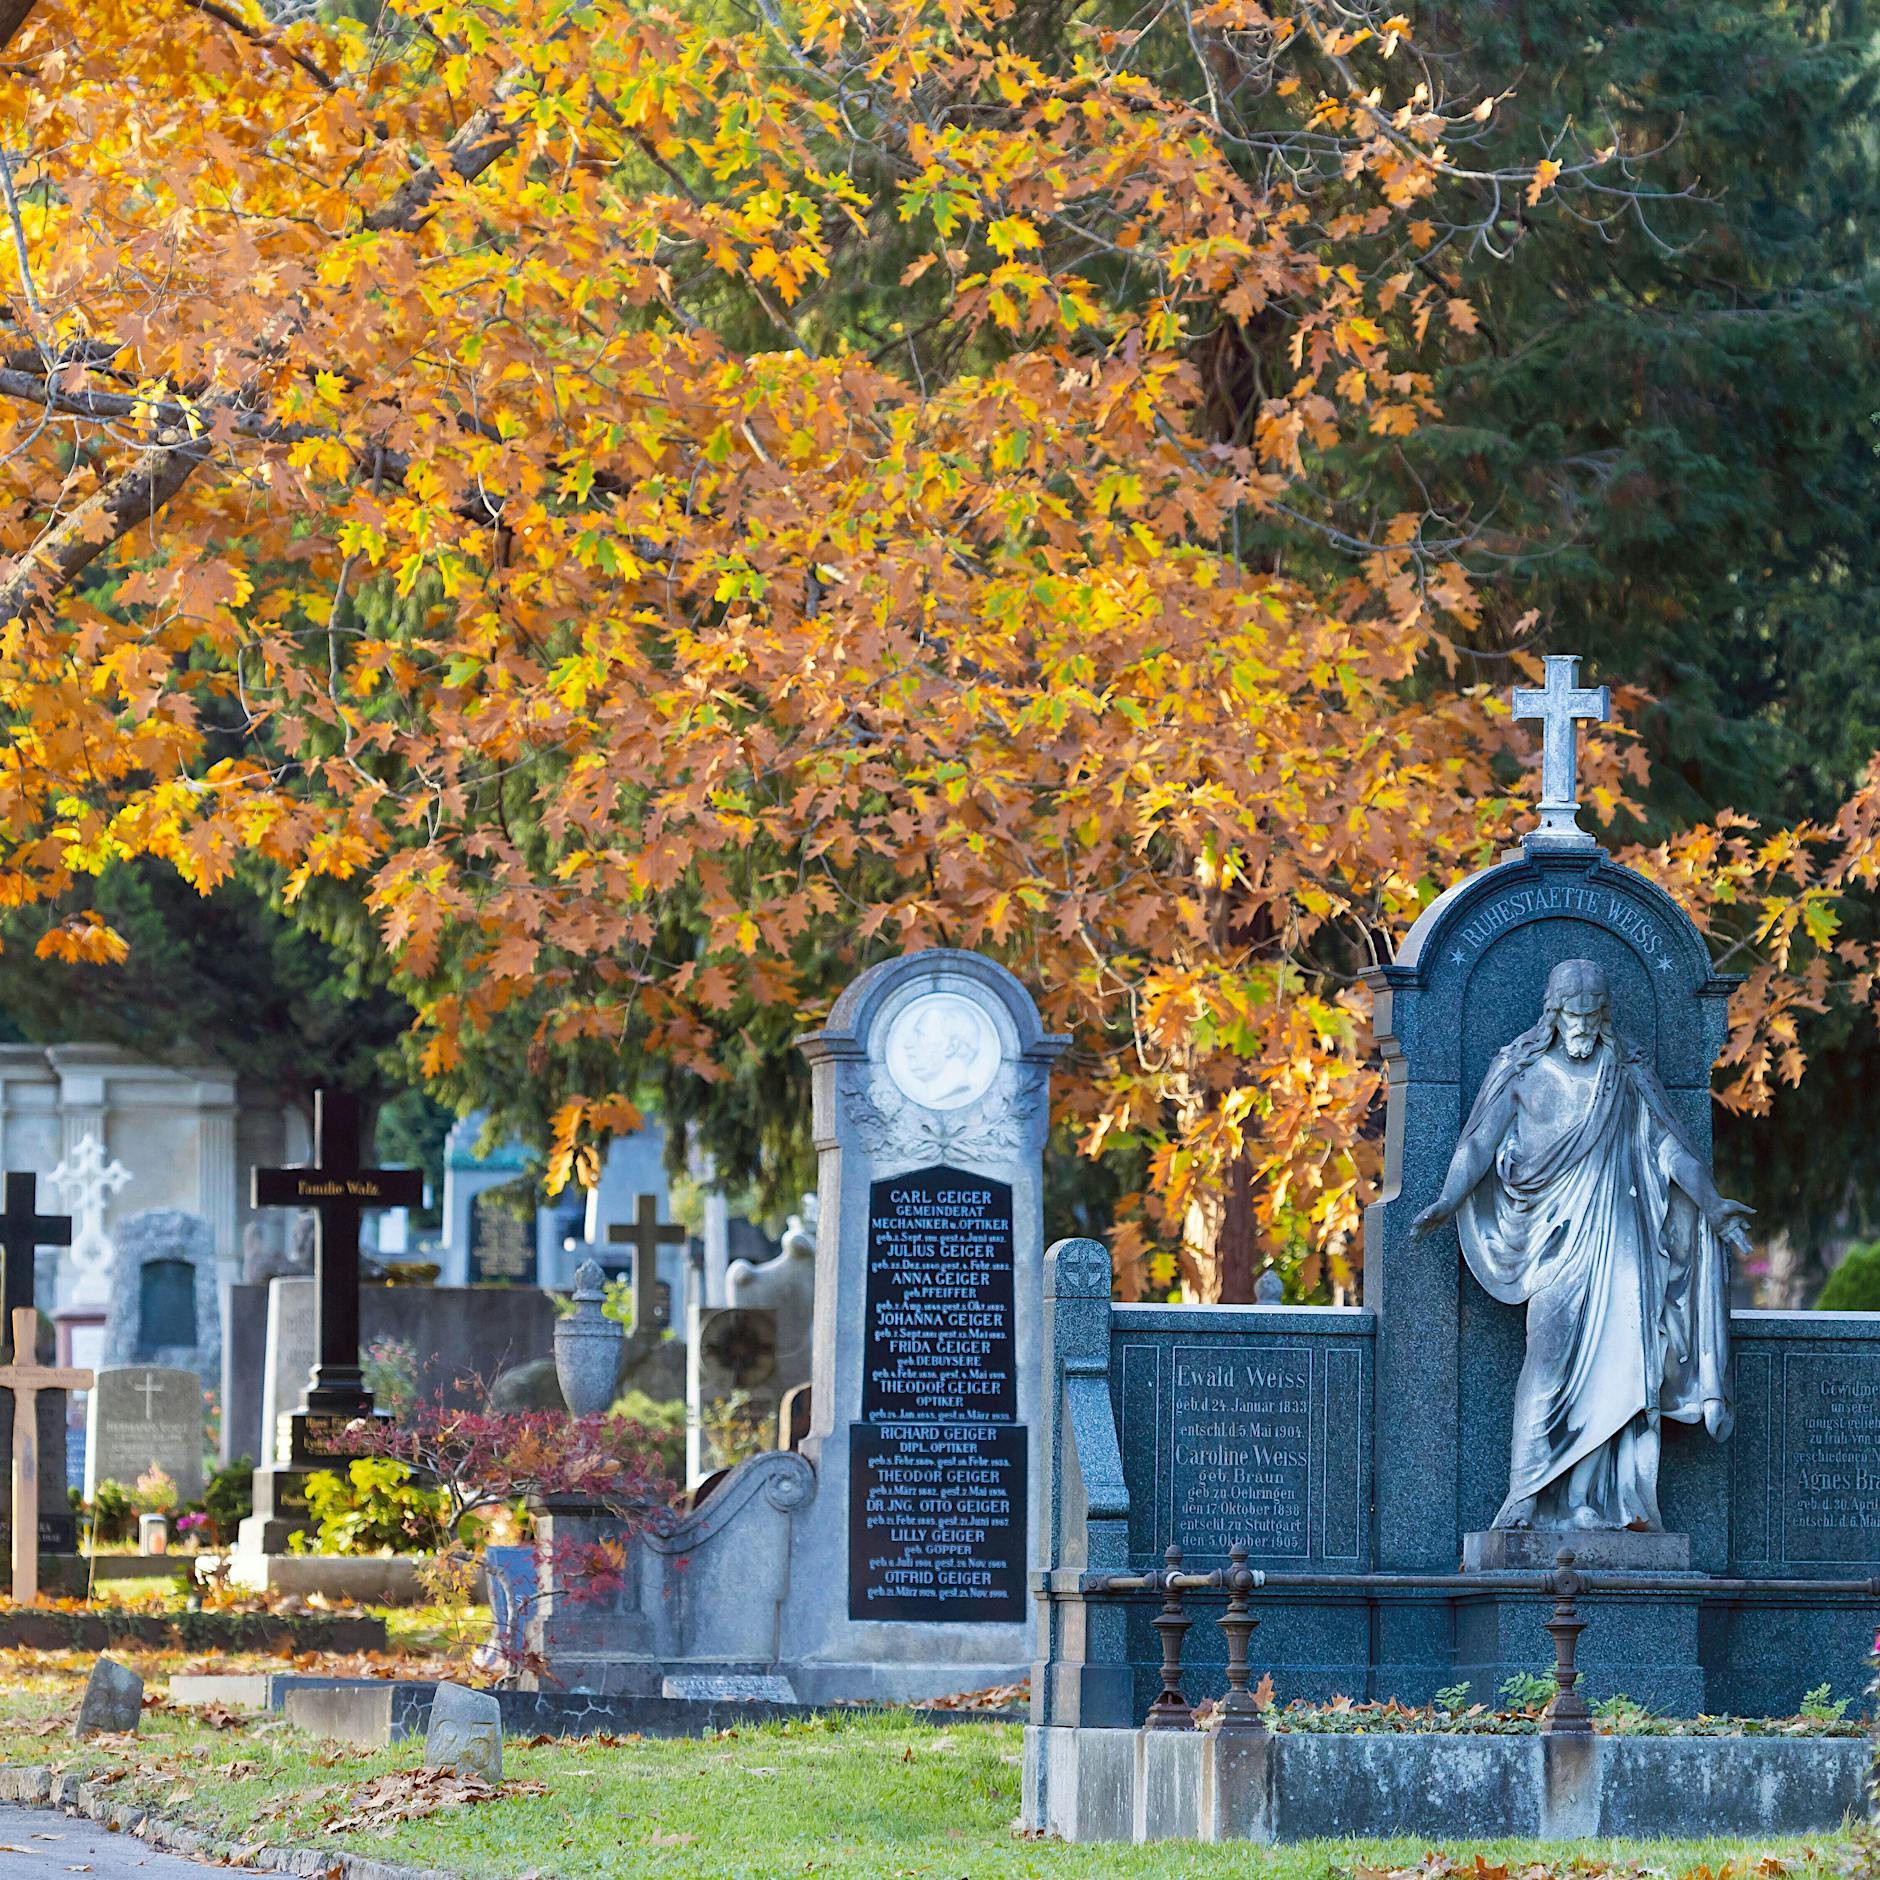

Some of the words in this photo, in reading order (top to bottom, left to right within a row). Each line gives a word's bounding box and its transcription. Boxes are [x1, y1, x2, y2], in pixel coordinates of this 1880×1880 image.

[1460, 886, 1600, 949] RUHESTAETTE
[1606, 900, 1665, 954] WEISS
[298, 1181, 345, 1196] Familie
[890, 1190, 932, 1204] CARL
[936, 1190, 992, 1204] GEIGER
[896, 1205, 985, 1217] GEMEINDERAT
[887, 1244, 935, 1258] JULIUS
[940, 1244, 995, 1258] GEIGER
[891, 1272, 932, 1285] ANNA
[935, 1272, 990, 1285] GEIGER
[877, 1313, 943, 1327] JOHANNA
[948, 1313, 1003, 1327] GEIGER
[889, 1341, 931, 1354] FRIDA
[936, 1341, 991, 1354] GEIGER
[1178, 1365, 1234, 1388] Ewald
[1247, 1365, 1306, 1388] Weiss
[880, 1381, 944, 1395] THEODOR
[948, 1381, 1001, 1395] GEIGER
[915, 1396, 964, 1407] OPTIKER
[1231, 1398, 1275, 1413] Januar
[1279, 1400, 1307, 1413] 1833
[880, 1427, 940, 1440] RICHARD
[943, 1427, 997, 1440] GEIGER
[1249, 1423, 1272, 1438] Mai
[1175, 1443, 1249, 1467] Caroline
[1252, 1443, 1307, 1467] Weiss
[878, 1470, 942, 1483] THEODOR
[946, 1470, 1000, 1483] GEIGER
[1199, 1468, 1229, 1488] geb.
[1233, 1468, 1284, 1484] Braun
[1799, 1468, 1851, 1494] Agnes
[1230, 1486, 1296, 1505] Oehringen
[919, 1500, 953, 1513] OTTO
[956, 1500, 1010, 1513] GEIGER
[1182, 1501, 1203, 1515] den
[1220, 1502, 1270, 1515] Oktober
[1227, 1519, 1242, 1531] zu
[1245, 1519, 1301, 1536] Stuttgart
[891, 1529, 928, 1542] LILLY
[931, 1529, 985, 1542] GEIGER
[1182, 1533, 1205, 1547] den
[1219, 1533, 1269, 1548] Oktober
[884, 1571, 934, 1585] OTFRID
[938, 1571, 992, 1585] GEIGER
